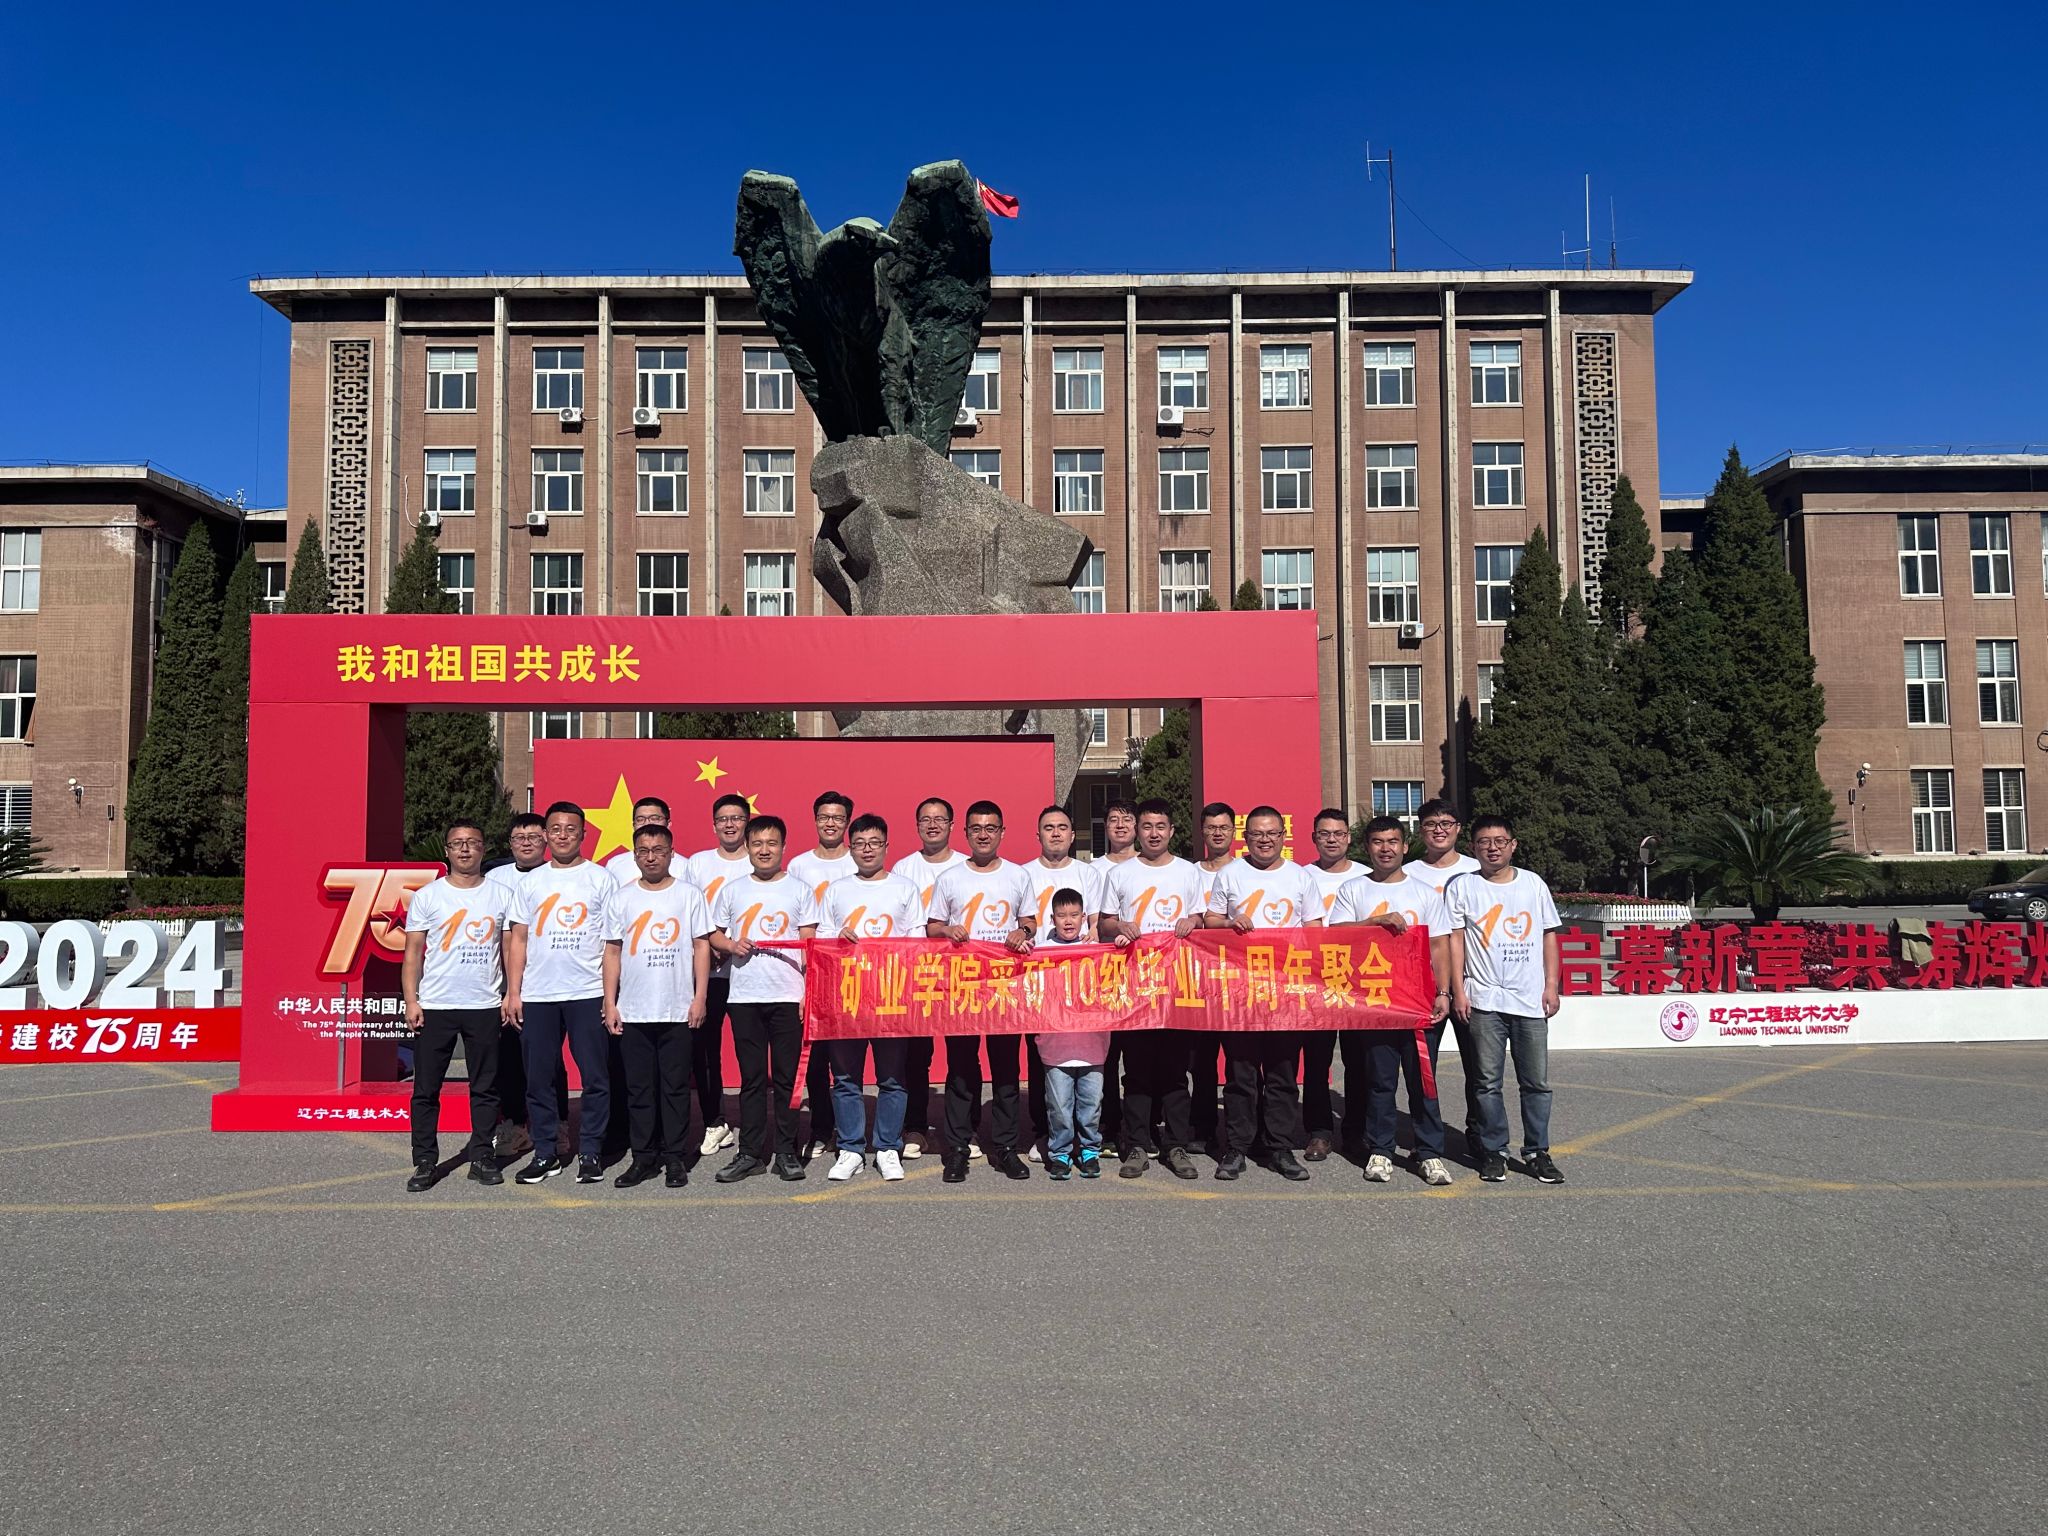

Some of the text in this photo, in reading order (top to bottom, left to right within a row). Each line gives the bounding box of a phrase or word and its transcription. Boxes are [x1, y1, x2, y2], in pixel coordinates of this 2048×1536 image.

[337, 644, 641, 683] 我和祖国共成长
[0, 919, 229, 1010] 2024
[840, 941, 1393, 1019] 矿业学院采矿10级毕业十周年聚会
[302, 1020, 408, 1030] The 75th Anniversary of the
[1709, 1003, 1859, 1025] 辽宁工程技术大学
[0, 1017, 199, 1053] 建校75周年
[320, 1030, 334, 1038] the
[335, 1030, 369, 1040] People's
[370, 1030, 405, 1040] Republic
[1719, 1024, 1850, 1037] LIAONING TECHNICAL UNIVERSITY
[297, 1107, 410, 1119] 辽宁工程技术大
